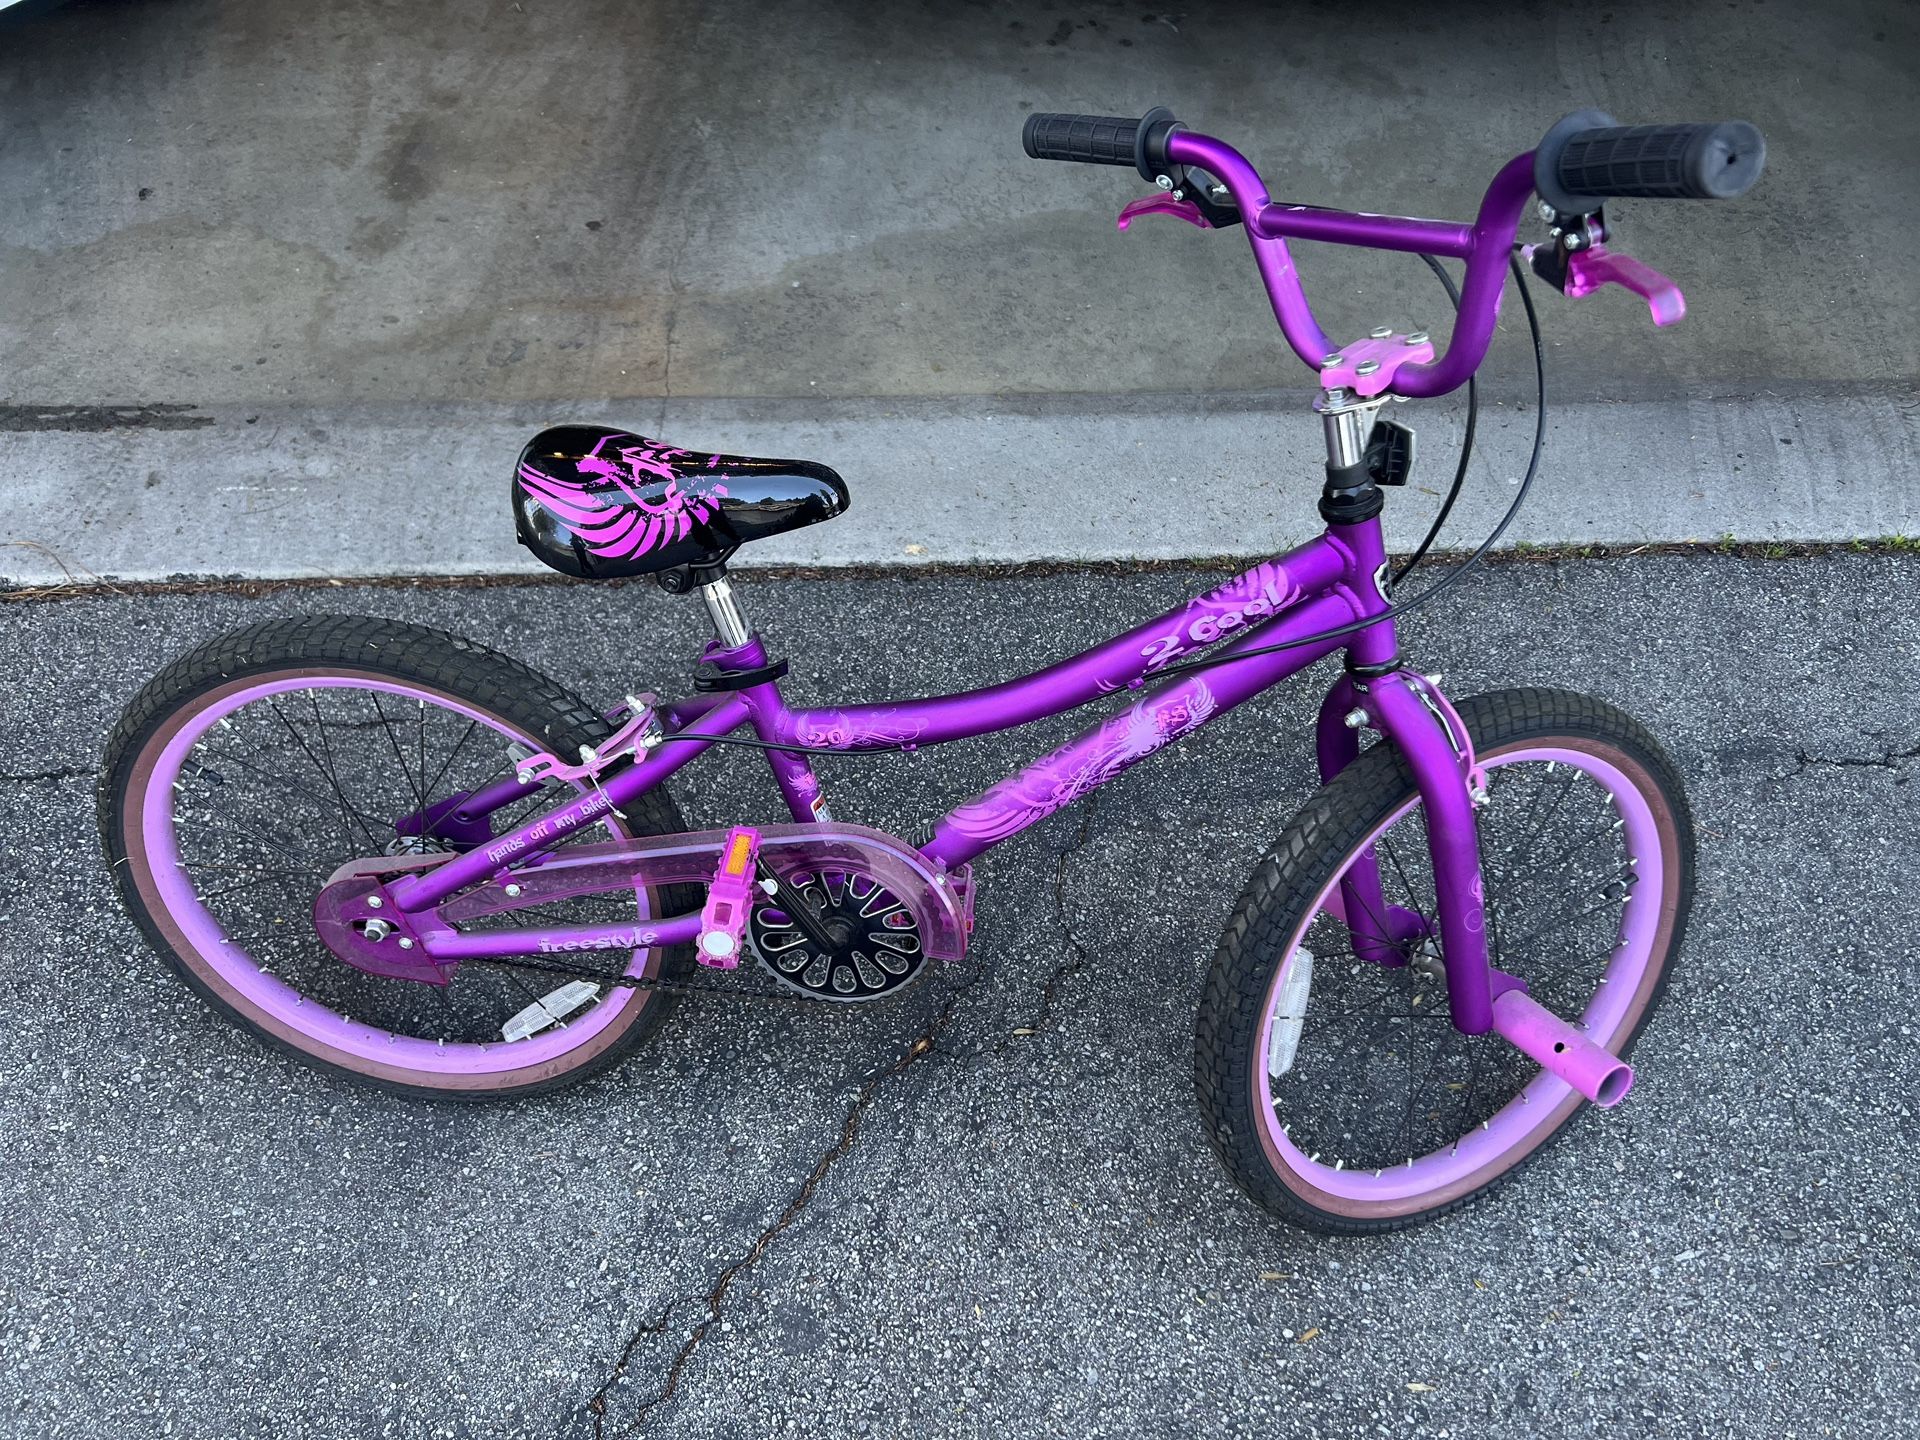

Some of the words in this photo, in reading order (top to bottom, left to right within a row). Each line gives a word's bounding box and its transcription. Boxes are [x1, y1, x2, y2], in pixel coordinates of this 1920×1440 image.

[1140, 635, 1184, 666] 2
[487, 836, 526, 864] hands
[530, 820, 550, 840] off
[553, 813, 577, 829] my
[537, 926, 659, 953] freestyle
